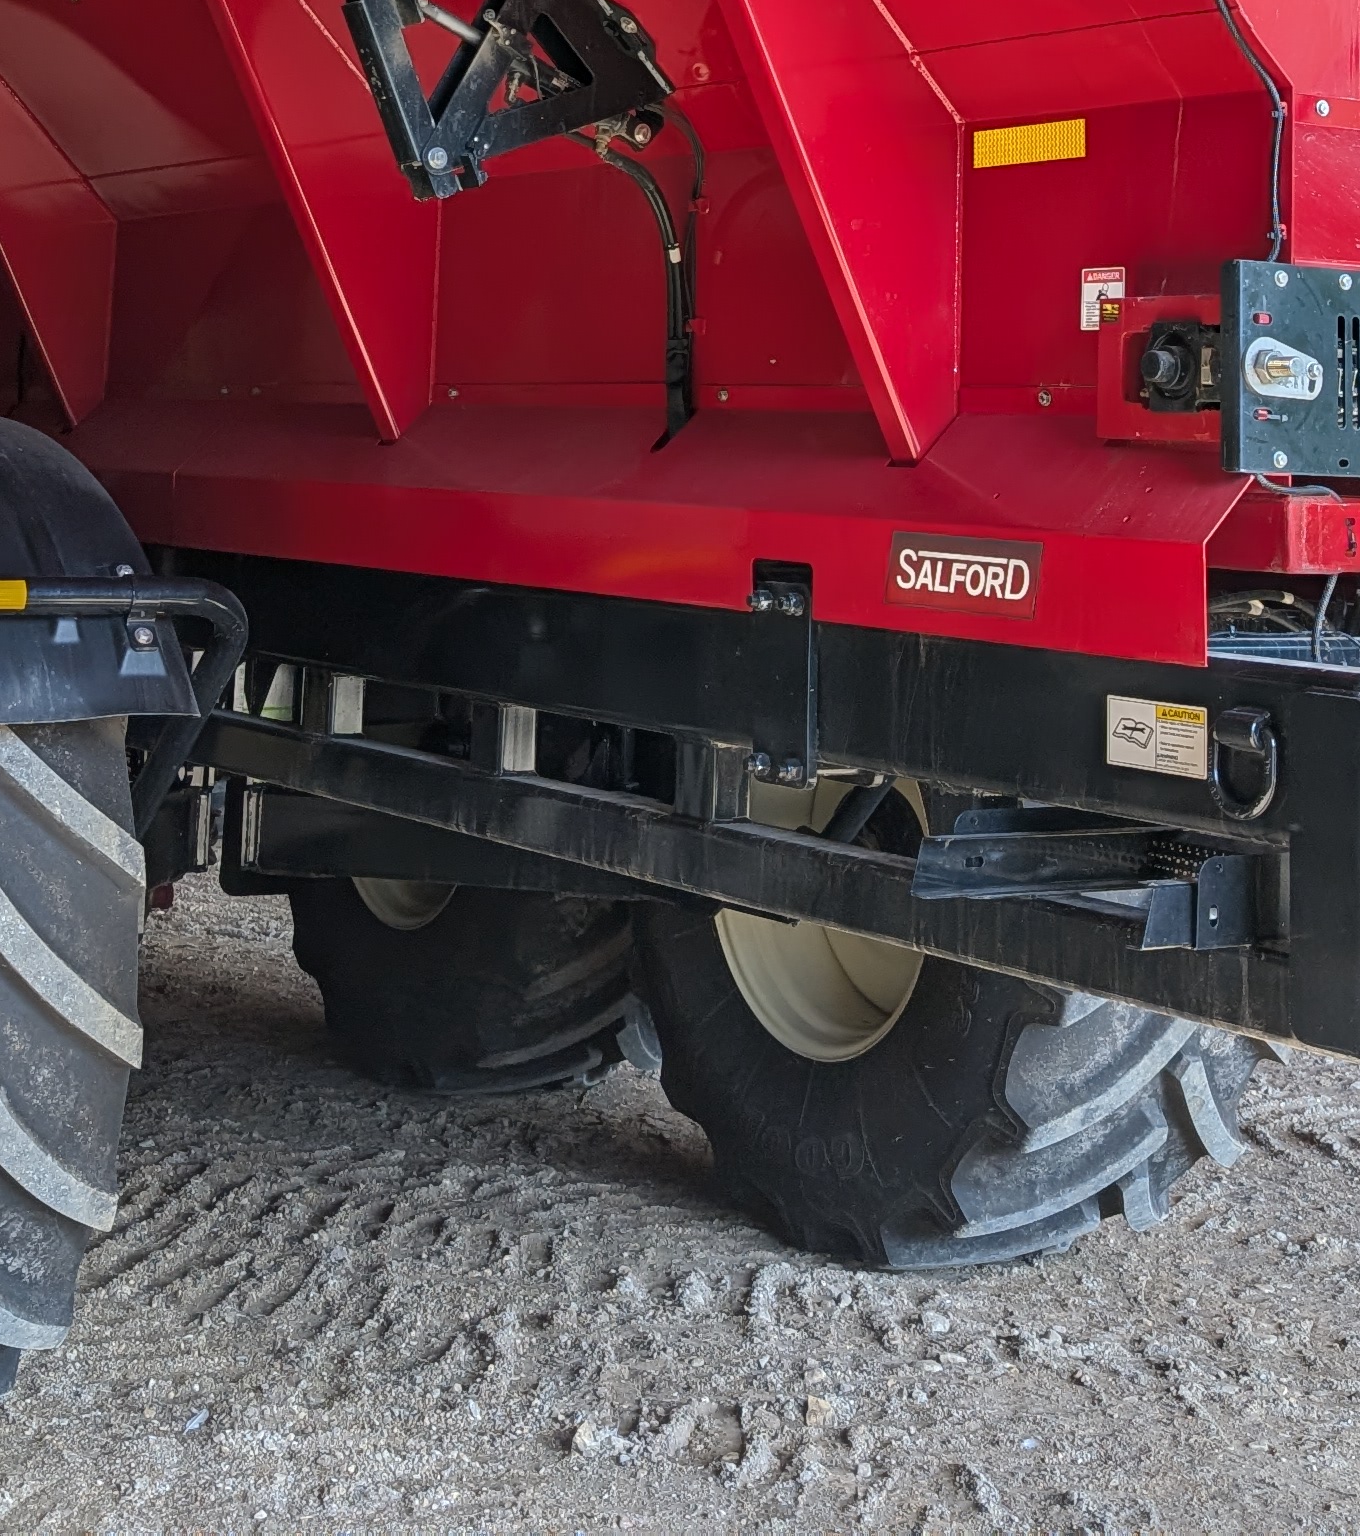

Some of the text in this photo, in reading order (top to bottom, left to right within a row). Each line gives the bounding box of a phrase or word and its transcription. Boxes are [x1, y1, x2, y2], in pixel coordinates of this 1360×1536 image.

[1092, 271, 1121, 281] DANGER
[896, 548, 1031, 601] SALFORD
[1167, 708, 1201, 721] CAUTION
